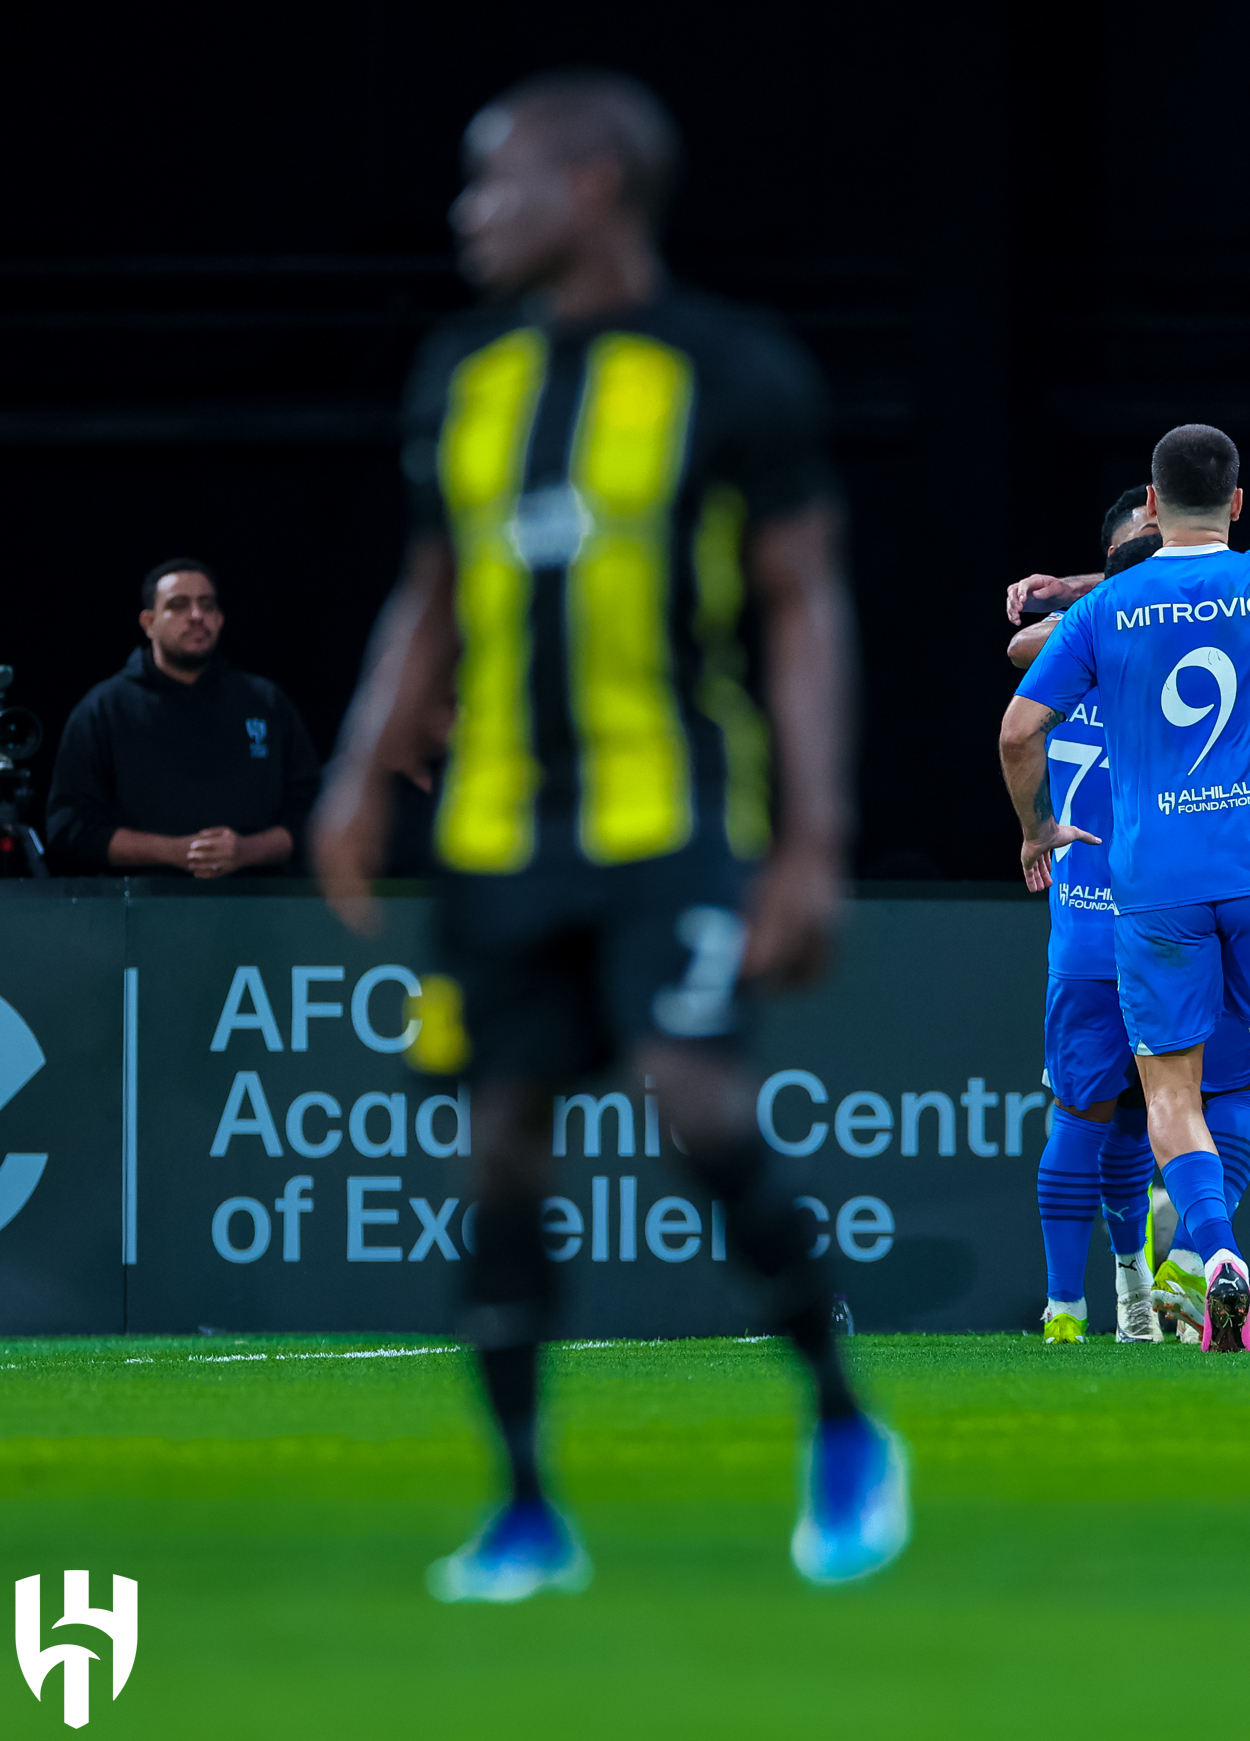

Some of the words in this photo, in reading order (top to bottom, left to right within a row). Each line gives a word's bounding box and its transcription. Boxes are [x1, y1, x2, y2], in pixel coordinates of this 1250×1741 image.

[1066, 703, 1104, 728] AL
[1161, 646, 1237, 776] 9
[1047, 738, 1110, 863] 7
[210, 964, 423, 1053] AFC
[210, 1071, 690, 1158] Acadmi
[756, 1068, 1054, 1158] Centr
[211, 1176, 314, 1264] of
[346, 1176, 896, 1264] Exellee
